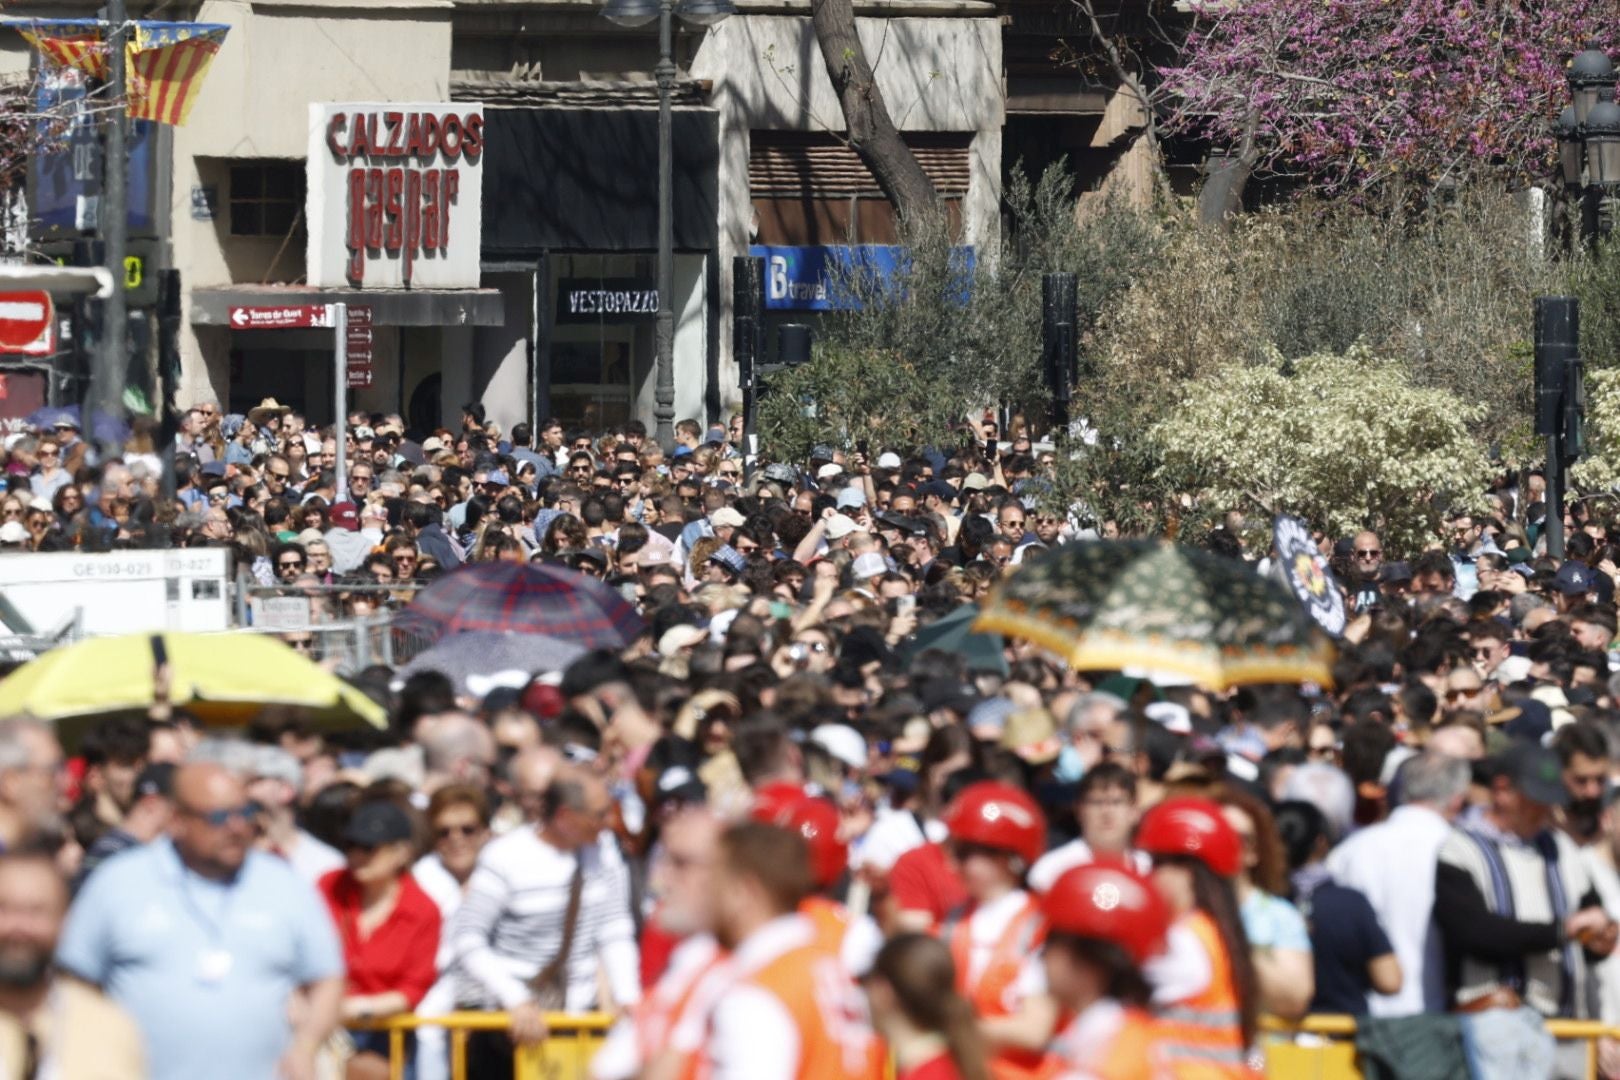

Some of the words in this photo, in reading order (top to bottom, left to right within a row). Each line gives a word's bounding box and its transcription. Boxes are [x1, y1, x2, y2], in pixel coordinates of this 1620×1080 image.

[328, 112, 483, 158] CALZADOS
[771, 255, 787, 299] B
[788, 278, 826, 300] travel
[569, 290, 659, 313] VESTOPAZZO
